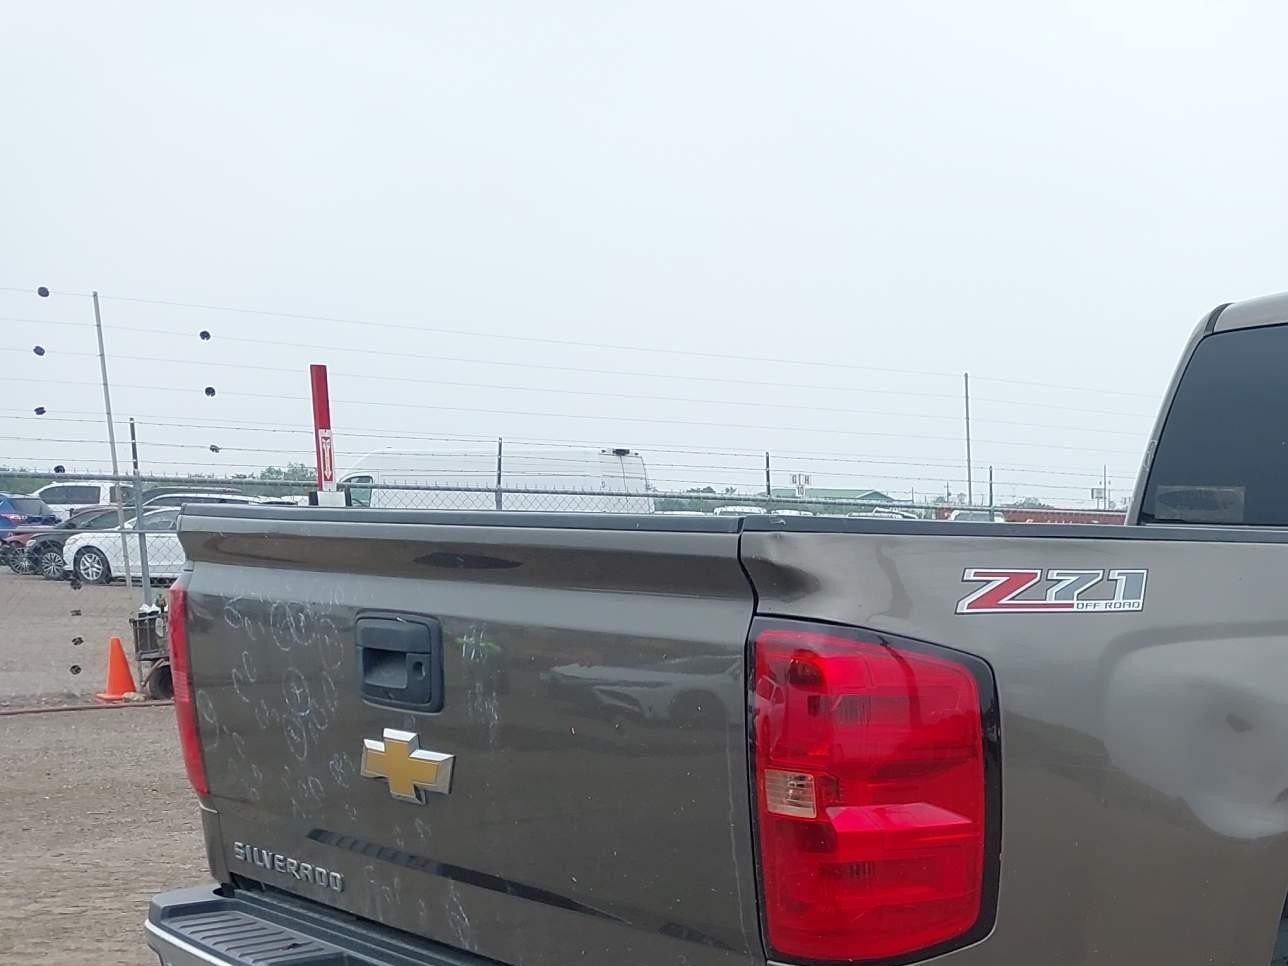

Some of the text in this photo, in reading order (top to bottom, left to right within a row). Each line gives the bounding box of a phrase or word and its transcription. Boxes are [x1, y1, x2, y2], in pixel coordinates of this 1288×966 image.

[954, 567, 1149, 615] Z71
[1076, 601, 1142, 610] OFF ROAD
[233, 840, 344, 893] SILVERADO
